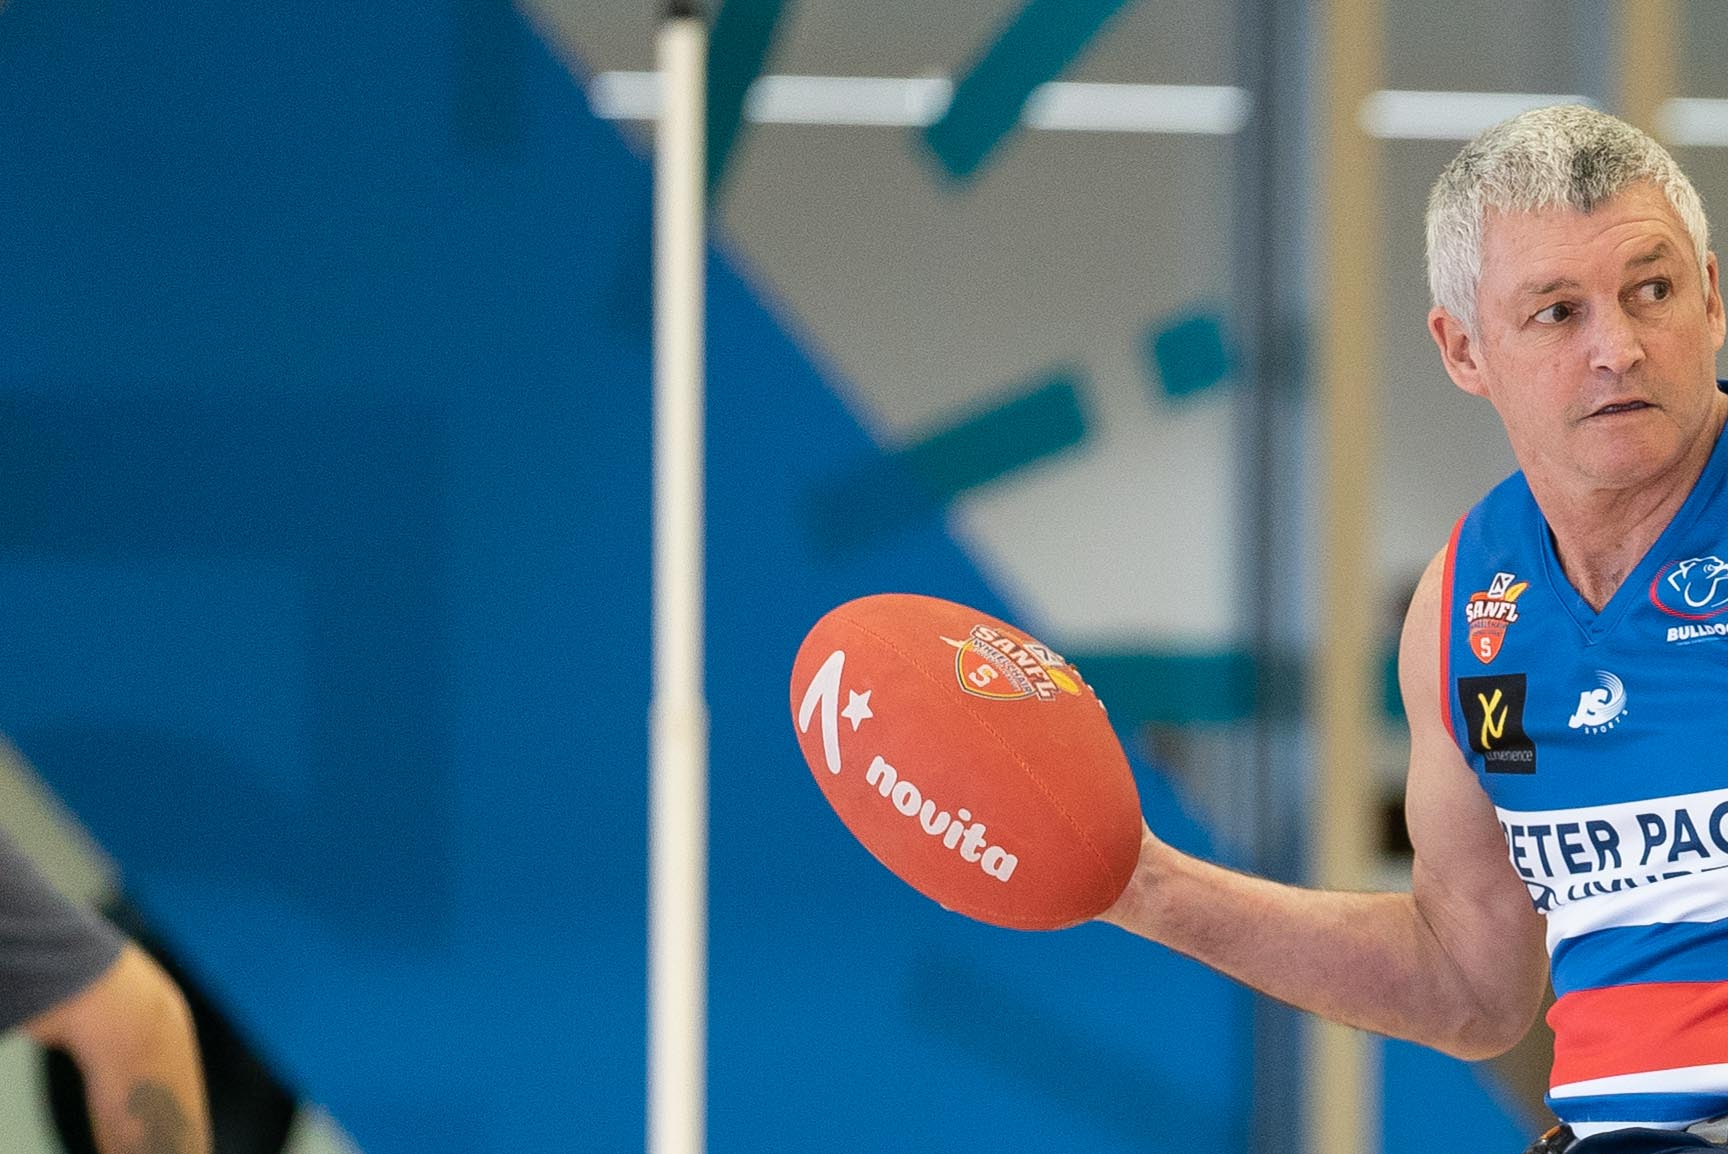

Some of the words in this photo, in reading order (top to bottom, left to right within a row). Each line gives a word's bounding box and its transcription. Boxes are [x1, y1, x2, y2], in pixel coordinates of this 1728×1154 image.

[1465, 600, 1519, 623] SANFL
[973, 625, 1059, 699] SANFL
[1480, 637, 1492, 657] S
[866, 755, 1018, 882] novita
